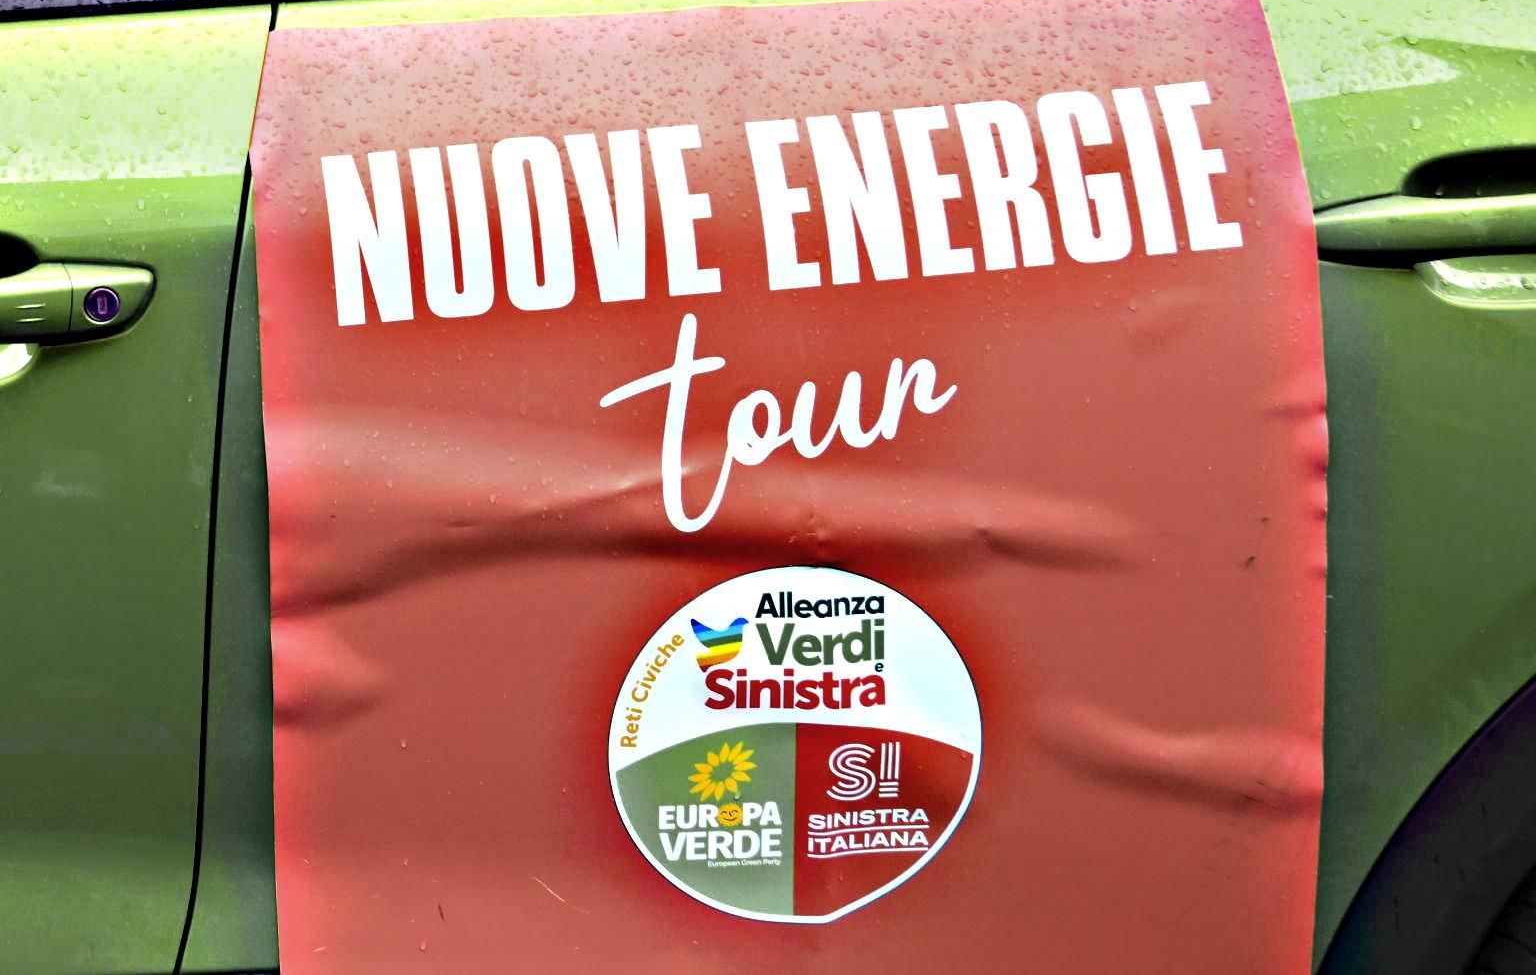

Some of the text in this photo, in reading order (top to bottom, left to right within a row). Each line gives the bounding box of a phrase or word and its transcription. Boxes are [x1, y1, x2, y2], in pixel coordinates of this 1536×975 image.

[320, 80, 1243, 327] NUOVE ENERGIE
[599, 313, 958, 532] tour
[755, 591, 885, 619] Alleanza
[755, 618, 885, 666] Verdi
[874, 661, 884, 673] e
[620, 633, 685, 748] Reti Civiche
[704, 668, 885, 710] Sinistra
[807, 808, 929, 830] SINISTRA
[659, 828, 782, 861] VERDE
[807, 831, 929, 854] ITALIANA
